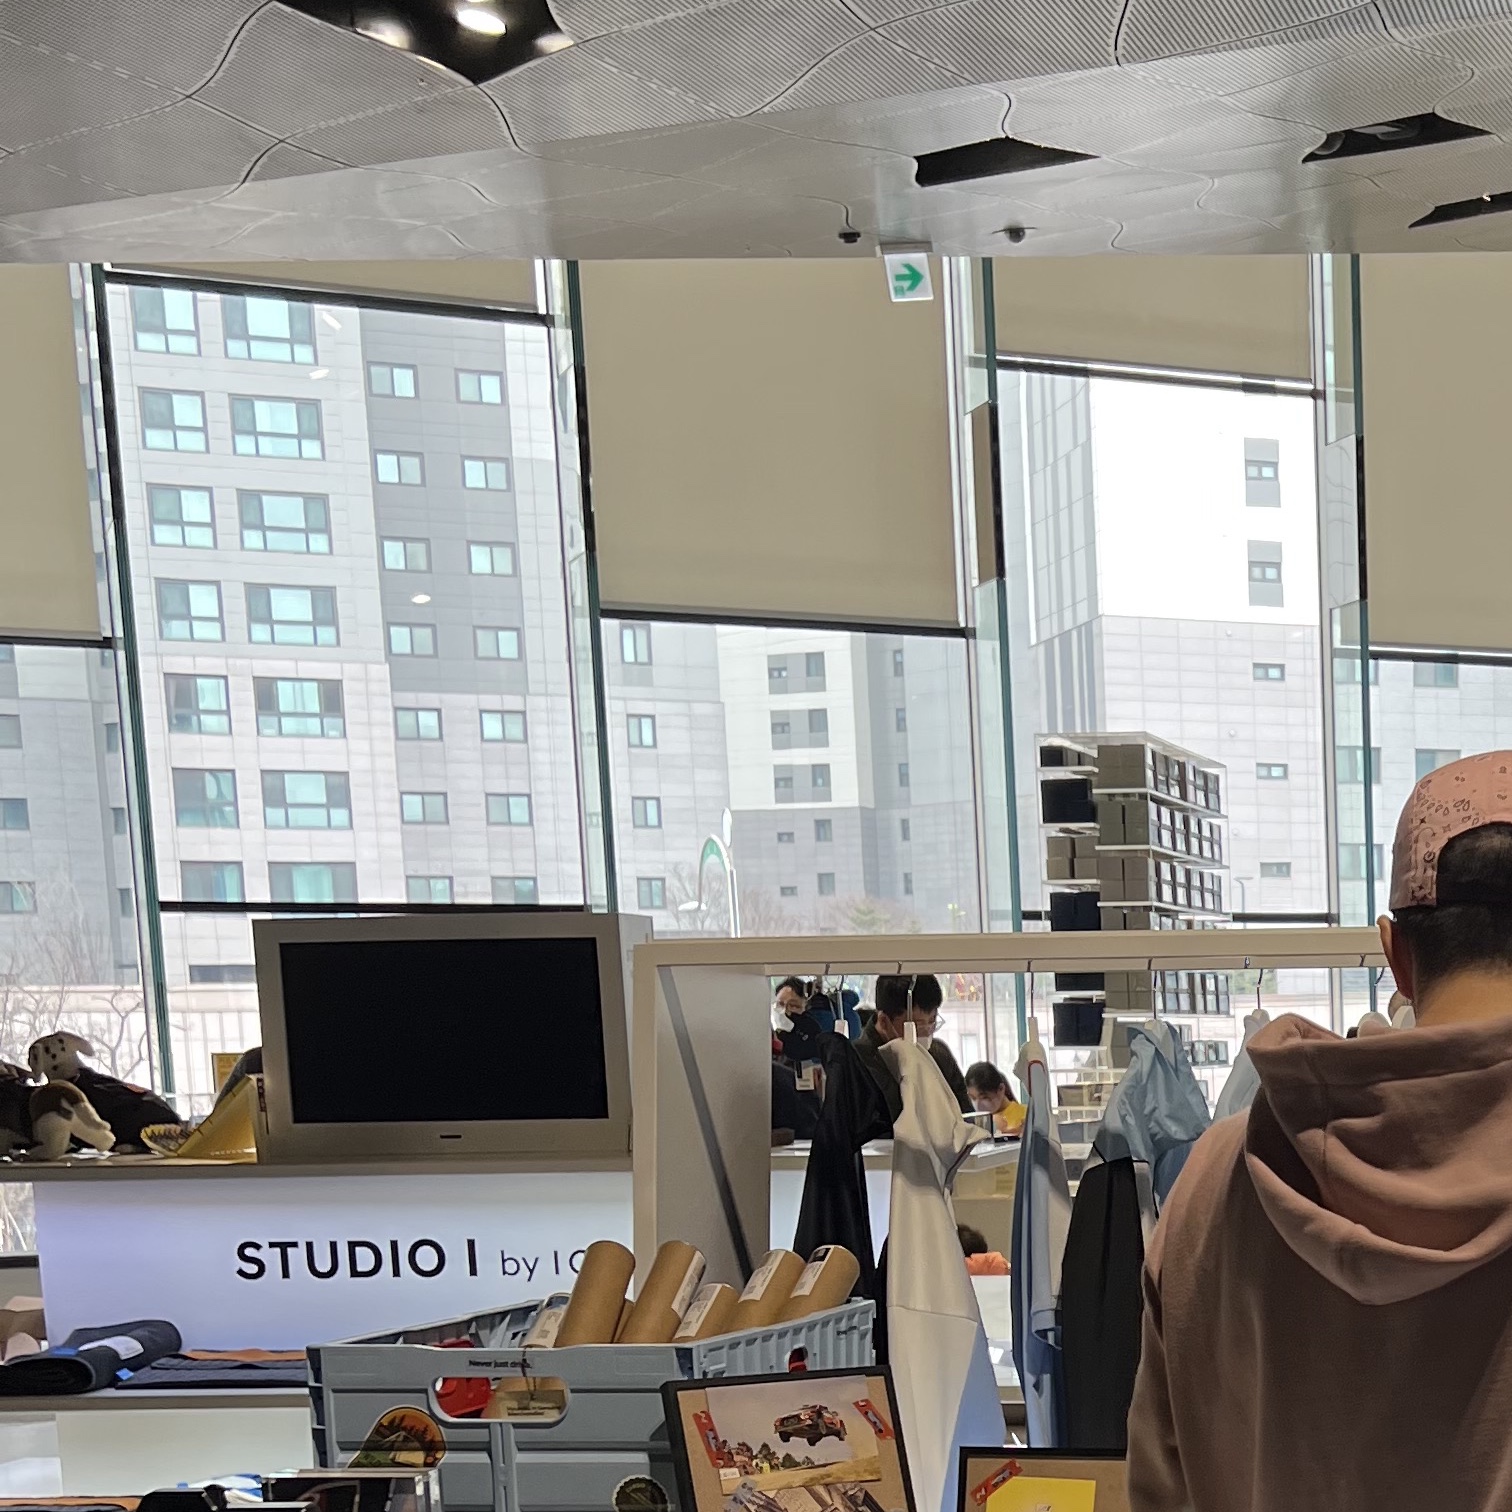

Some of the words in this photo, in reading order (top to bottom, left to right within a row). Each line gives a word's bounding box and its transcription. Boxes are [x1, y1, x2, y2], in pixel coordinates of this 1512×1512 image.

[236, 1238, 446, 1280] STUDIO
[466, 1238, 479, 1278] I
[500, 1249, 540, 1282] by
